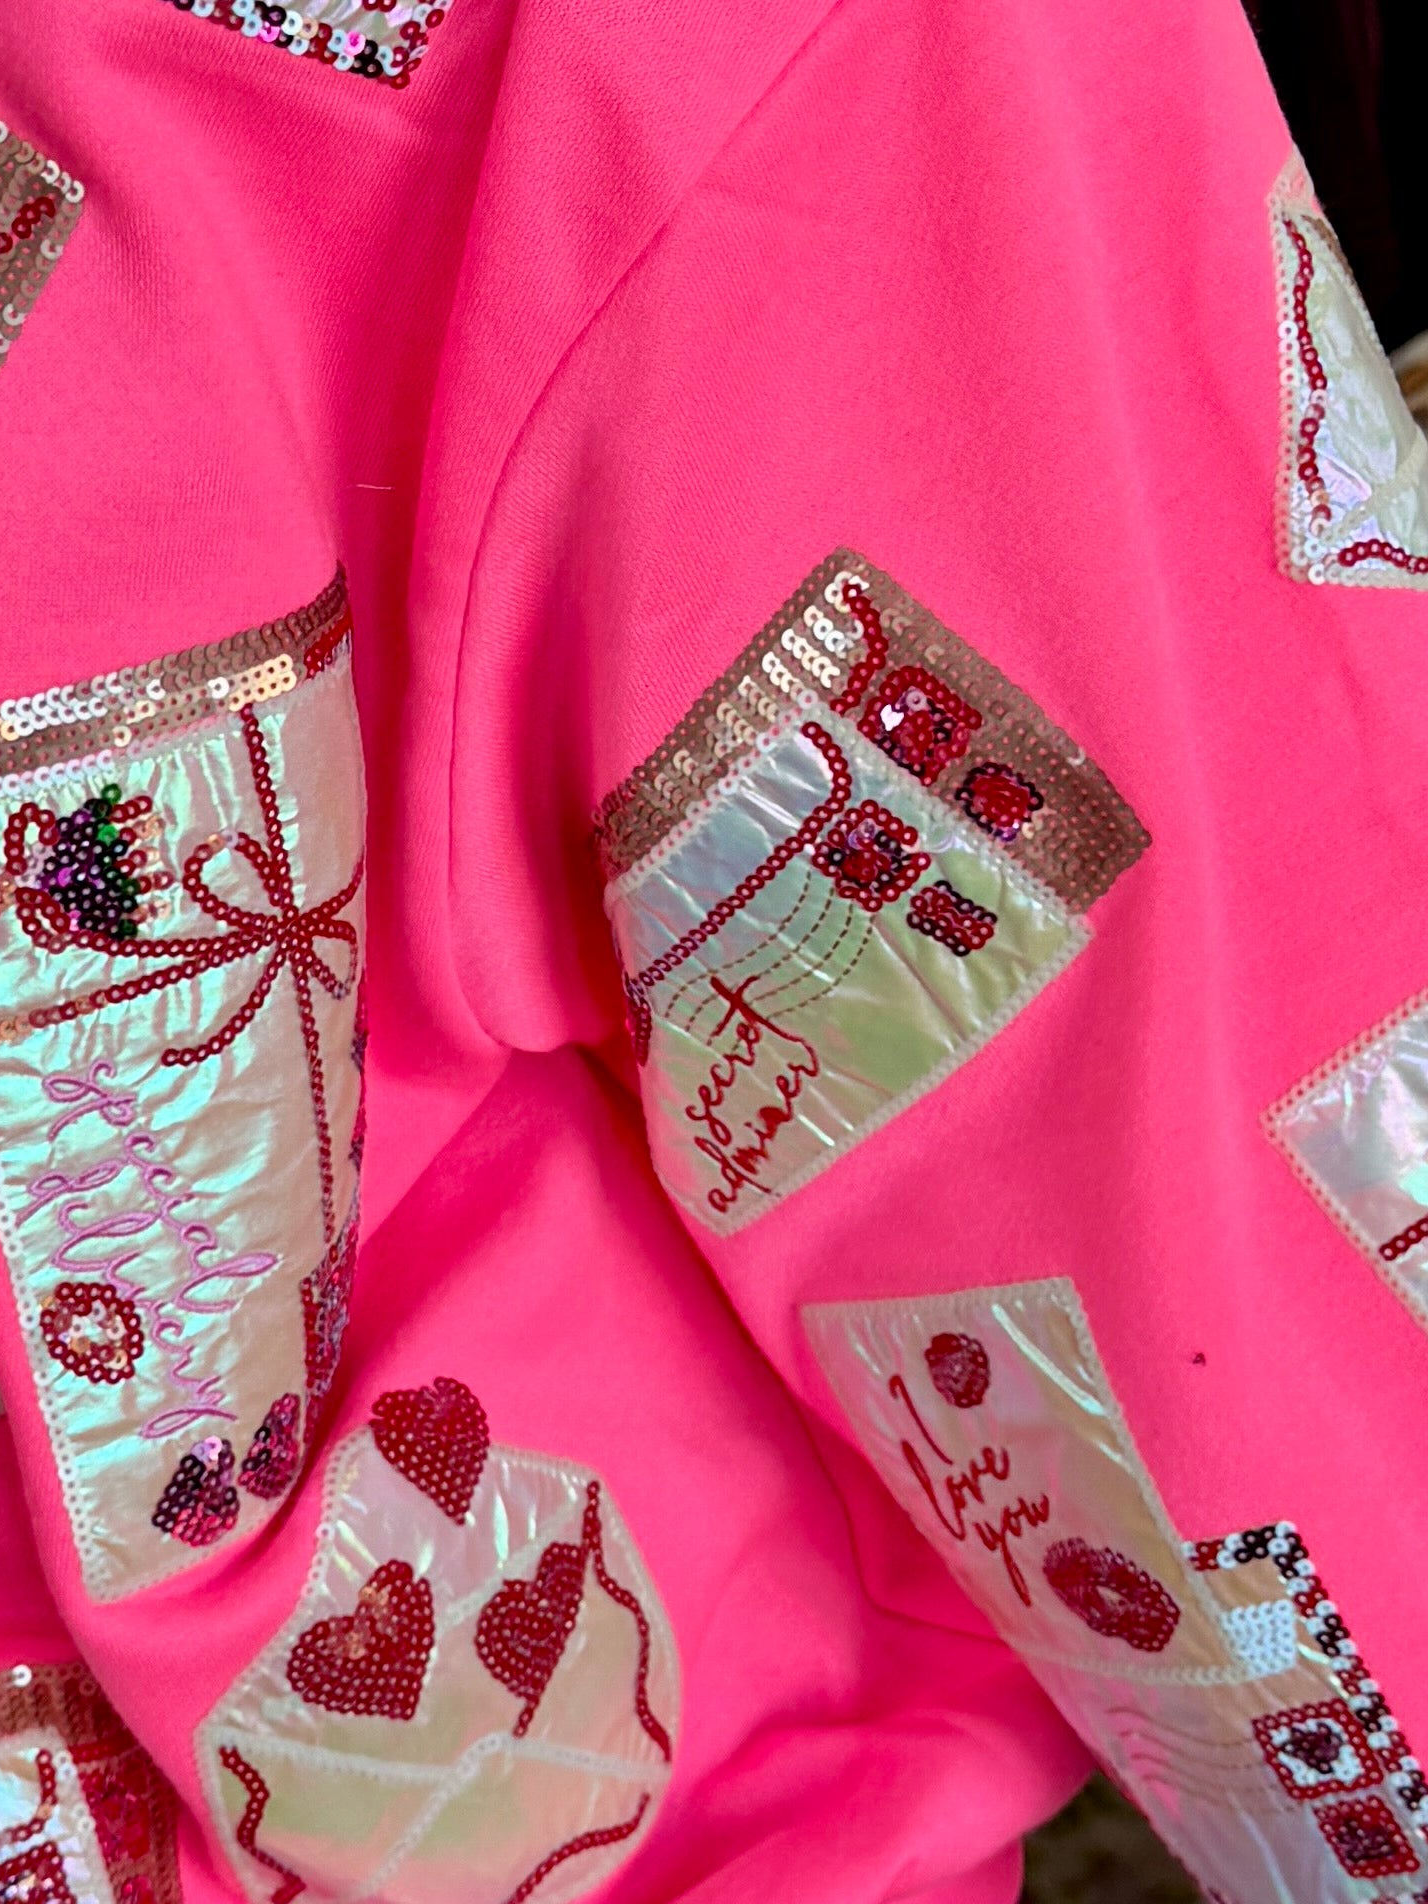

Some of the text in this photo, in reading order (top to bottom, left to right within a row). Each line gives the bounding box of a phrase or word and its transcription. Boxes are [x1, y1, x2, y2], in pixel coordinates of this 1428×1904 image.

[684, 974, 763, 1147] secret
[888, 1374, 954, 1466] I
[900, 1439, 1010, 1542] love
[973, 1492, 1050, 1608] you
